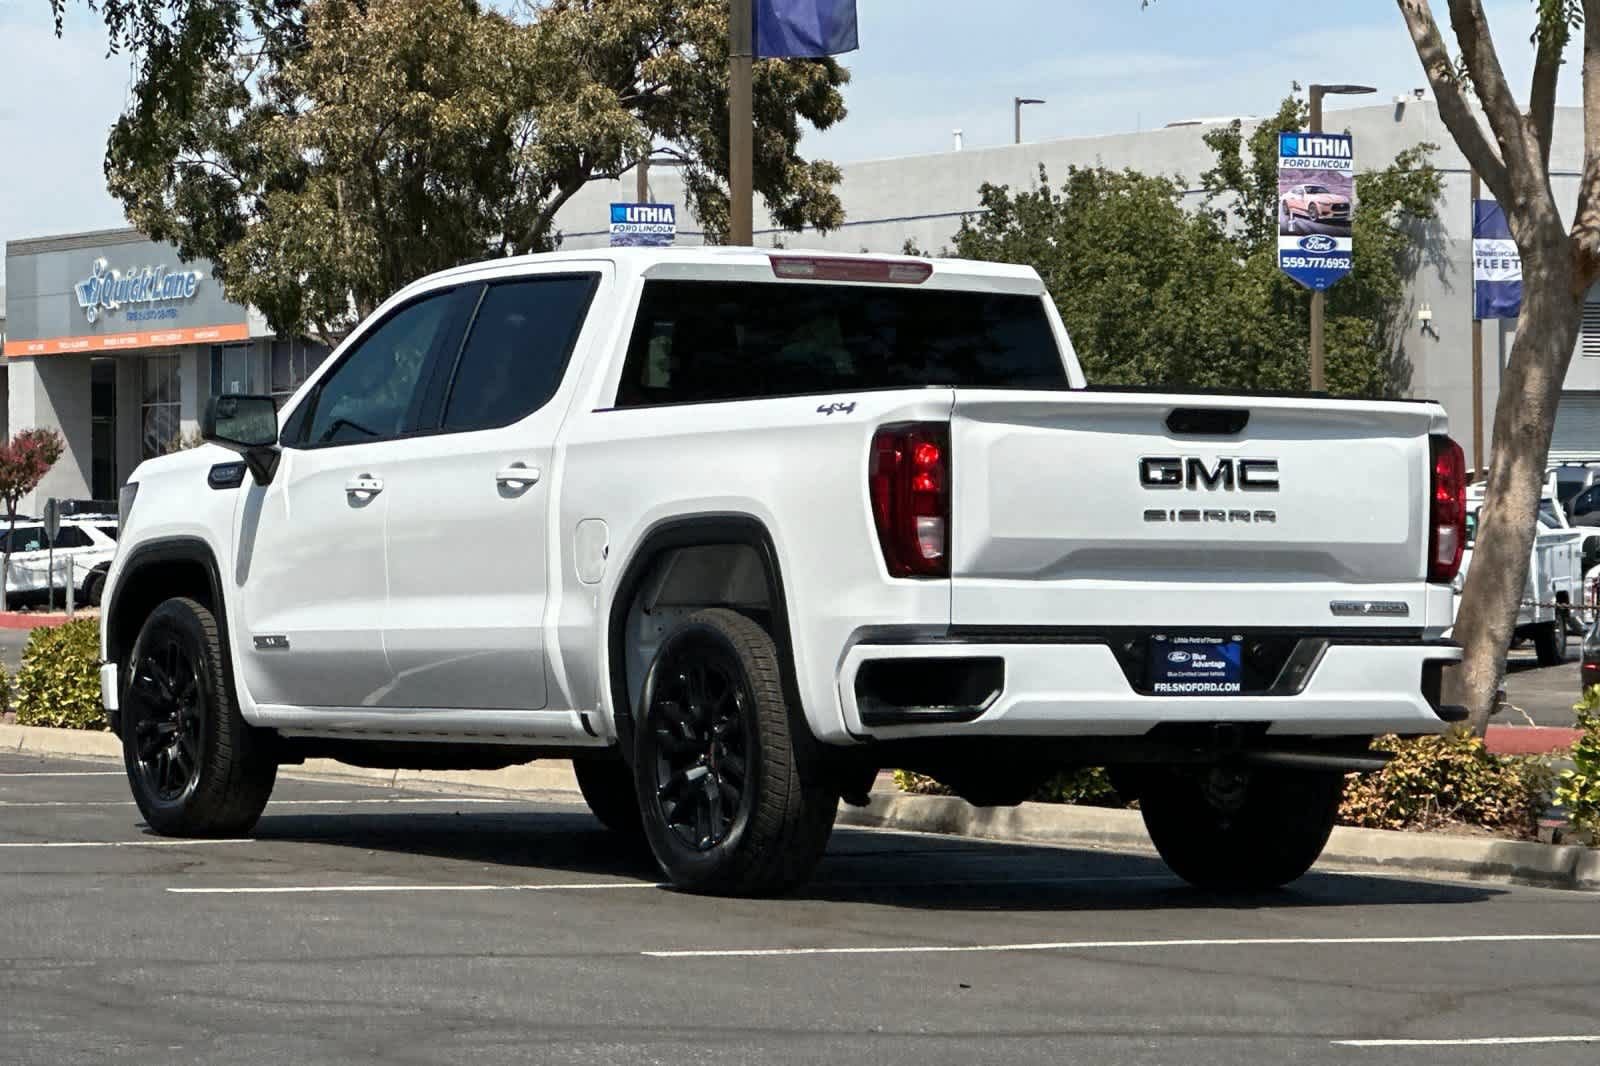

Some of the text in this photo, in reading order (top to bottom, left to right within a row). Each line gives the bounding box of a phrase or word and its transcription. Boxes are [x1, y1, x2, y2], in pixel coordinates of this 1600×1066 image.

[1298, 137, 1351, 158] LITHIA
[1283, 159, 1350, 169] FORD LINCOLN
[626, 207, 673, 223] LITHIA
[613, 224, 673, 233] FORD LINCOLN
[1305, 236, 1332, 250] Ford
[1282, 256, 1350, 269] 559.777.6952
[1476, 258, 1521, 270] FLEET
[101, 264, 200, 309] Quick Lane
[1139, 456, 1280, 491] GMC
[1143, 509, 1277, 523] SIERRA
[1191, 652, 1207, 661] Blue
[1191, 660, 1226, 669] Advantage
[1153, 682, 1241, 693] FRESNOFORD.COM
